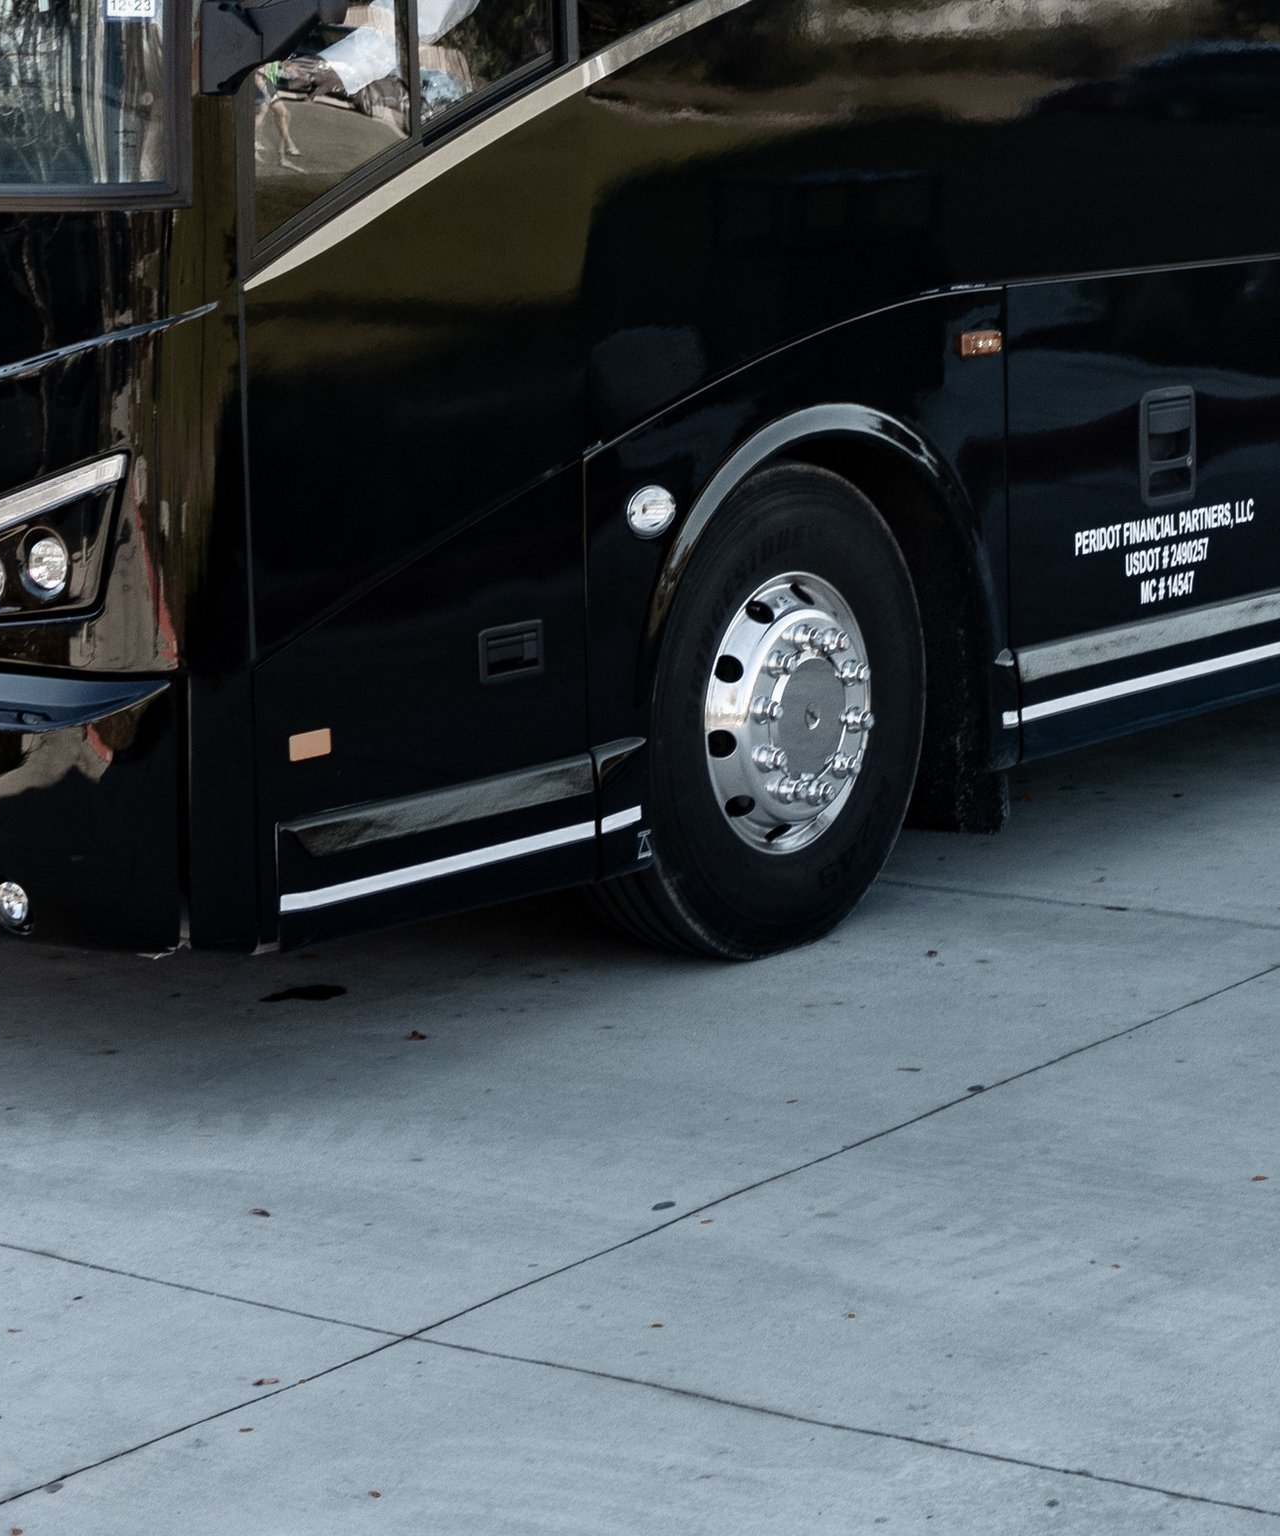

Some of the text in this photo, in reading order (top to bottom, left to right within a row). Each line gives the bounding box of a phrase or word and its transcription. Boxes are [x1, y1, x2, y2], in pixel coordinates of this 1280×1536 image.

[1074, 498, 1255, 557] PERIDOT FINANCIAL PARTNERS, LLC
[1125, 537, 1209, 577] USDOT # 2490257
[1140, 570, 1195, 605] MC # 14547
